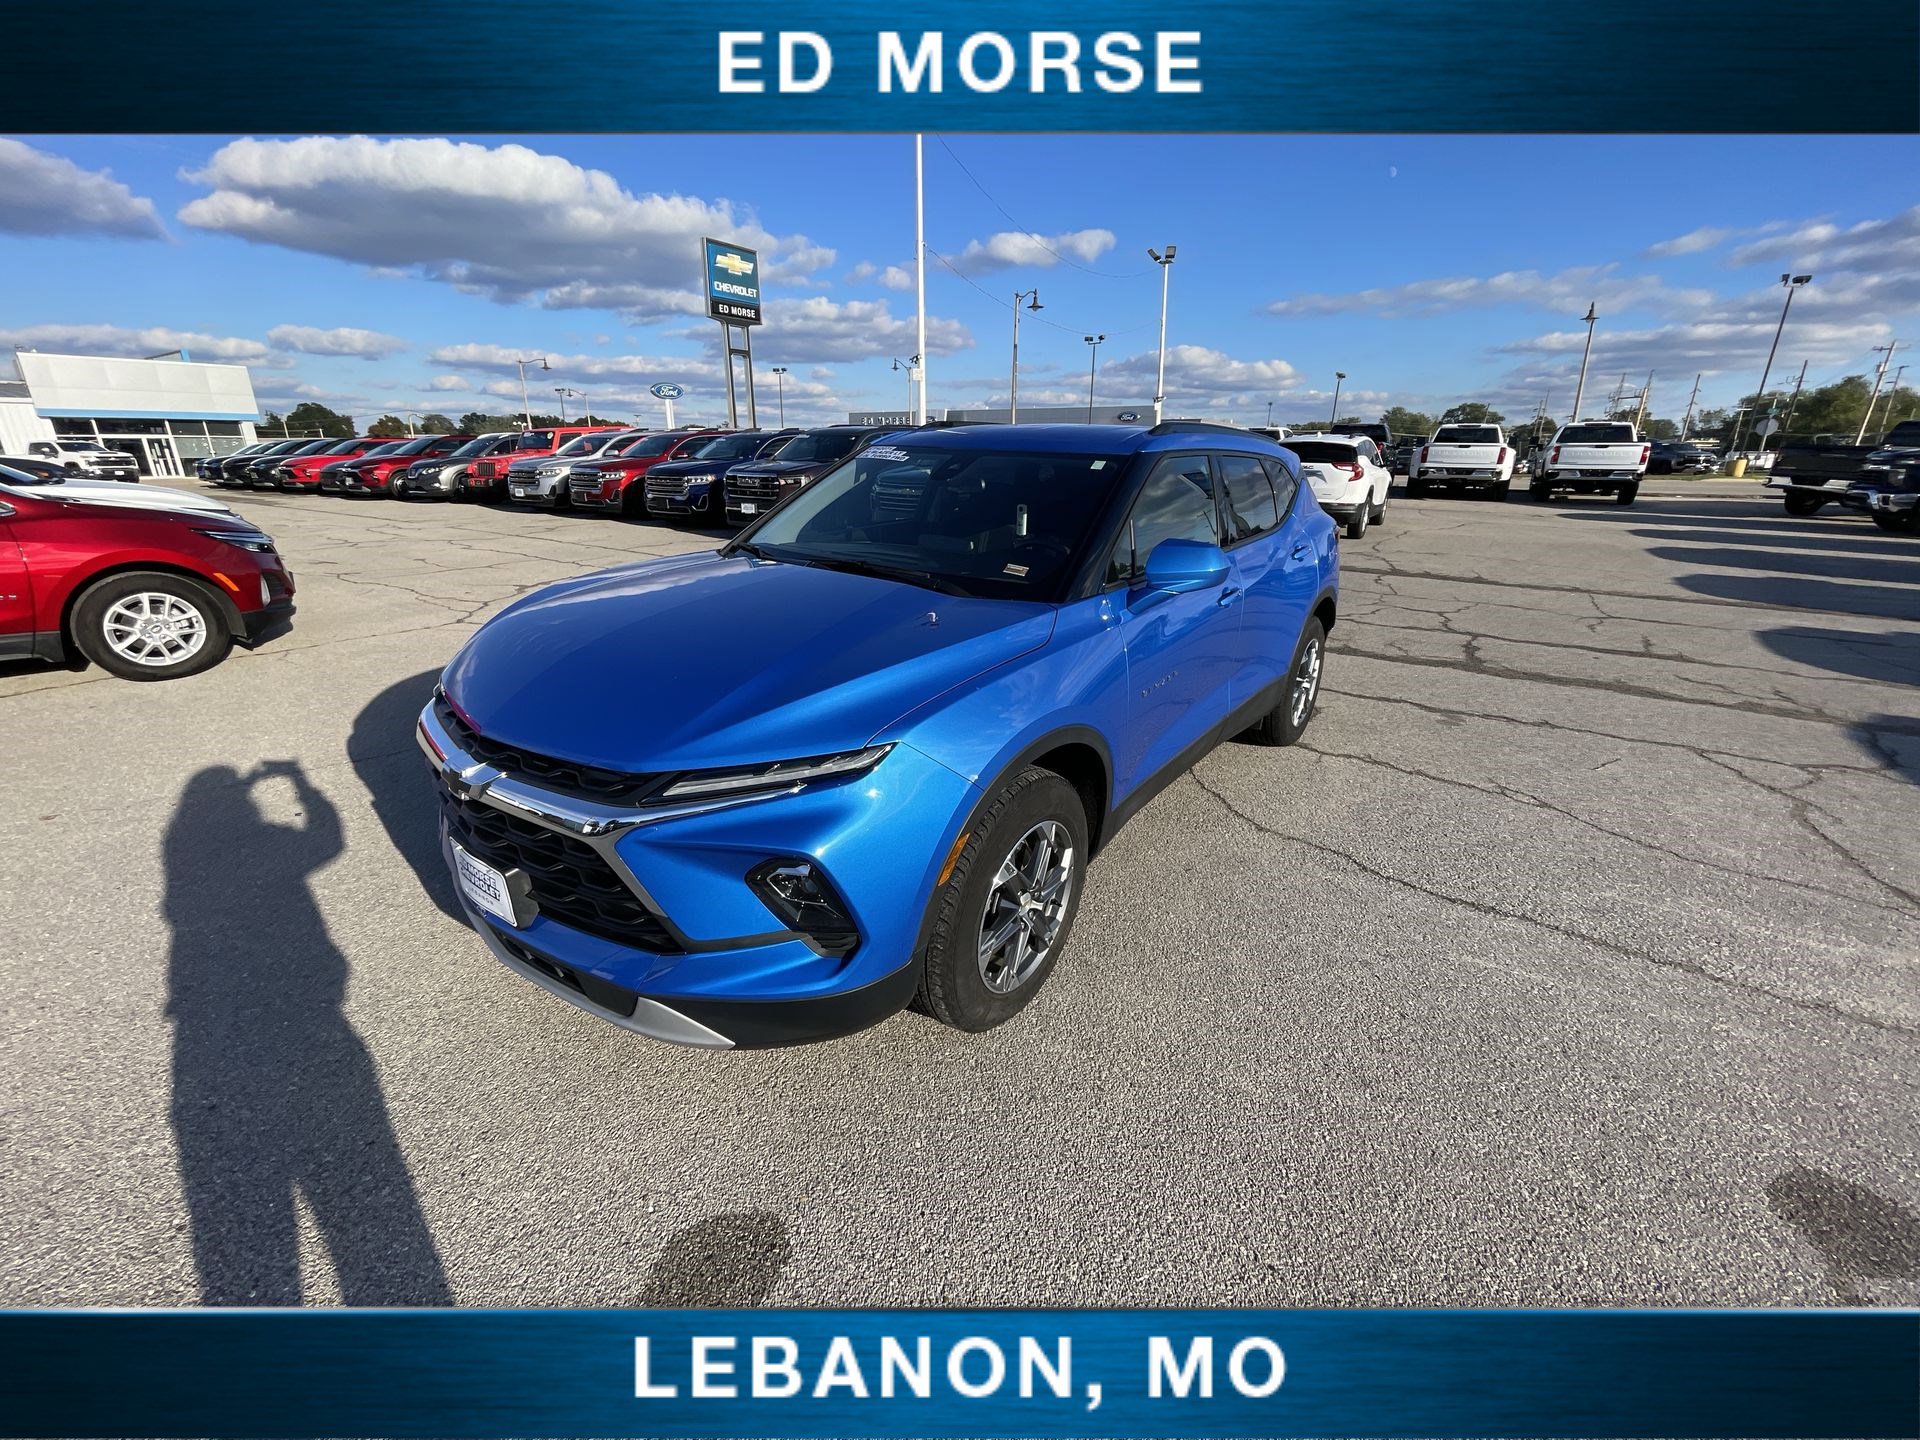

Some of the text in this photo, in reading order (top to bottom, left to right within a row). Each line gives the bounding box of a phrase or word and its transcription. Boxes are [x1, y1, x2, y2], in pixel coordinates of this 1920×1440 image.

[714, 281, 758, 298] CHEVROLET
[719, 304, 756, 318] ED MORSE
[467, 863, 497, 889] MORSE
